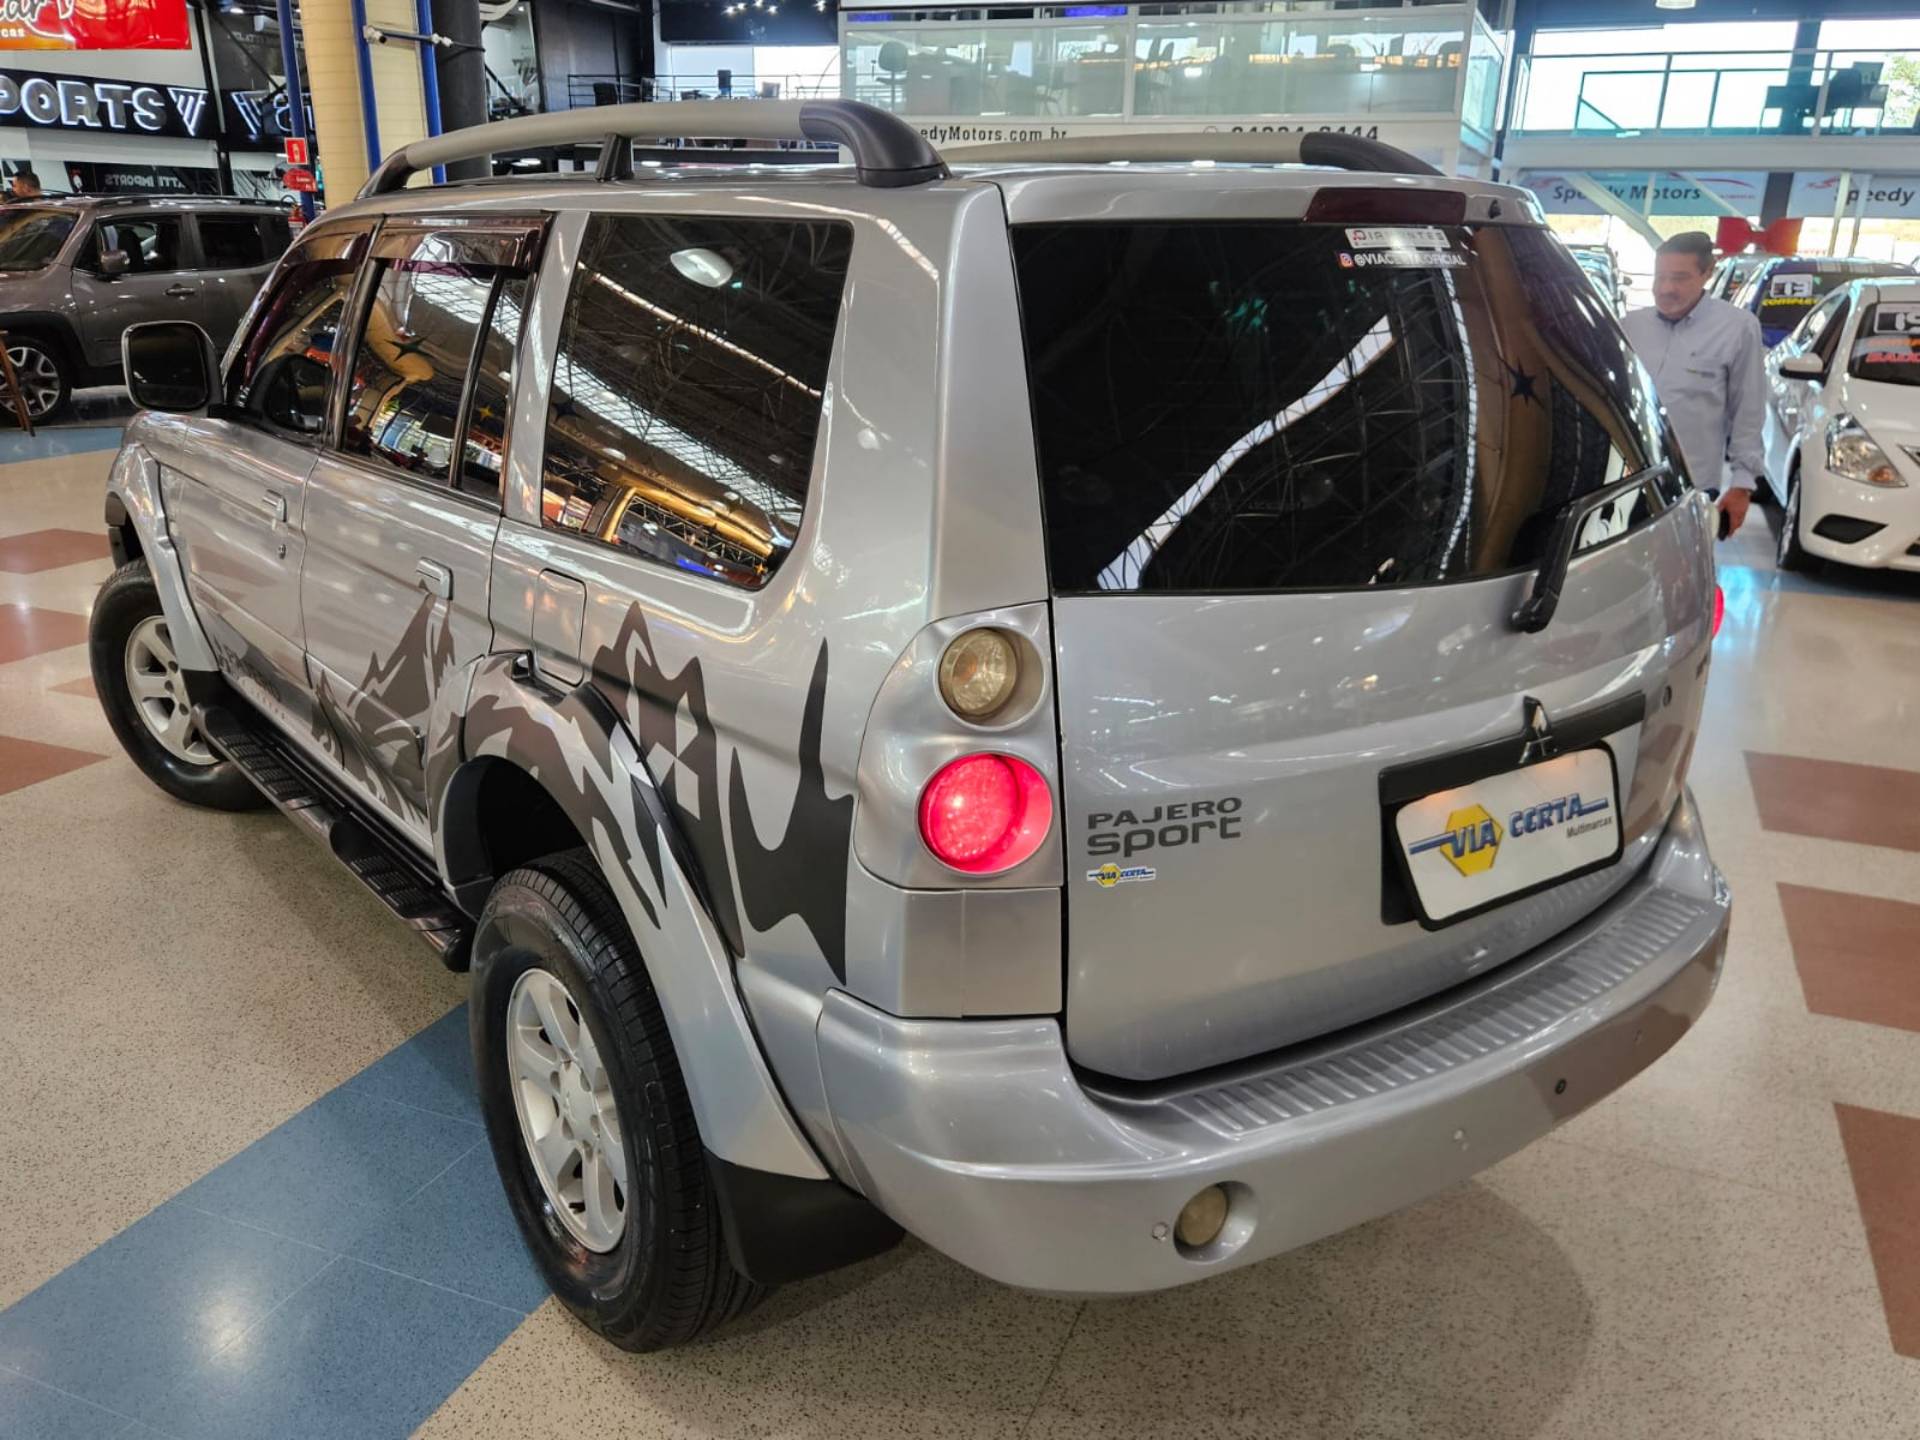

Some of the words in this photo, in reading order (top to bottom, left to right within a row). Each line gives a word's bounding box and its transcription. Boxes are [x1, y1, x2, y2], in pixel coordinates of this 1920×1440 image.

[1088, 797, 1242, 830] PAJERO
[1450, 818, 1498, 858] VIA
[1509, 793, 1584, 838] CERTA
